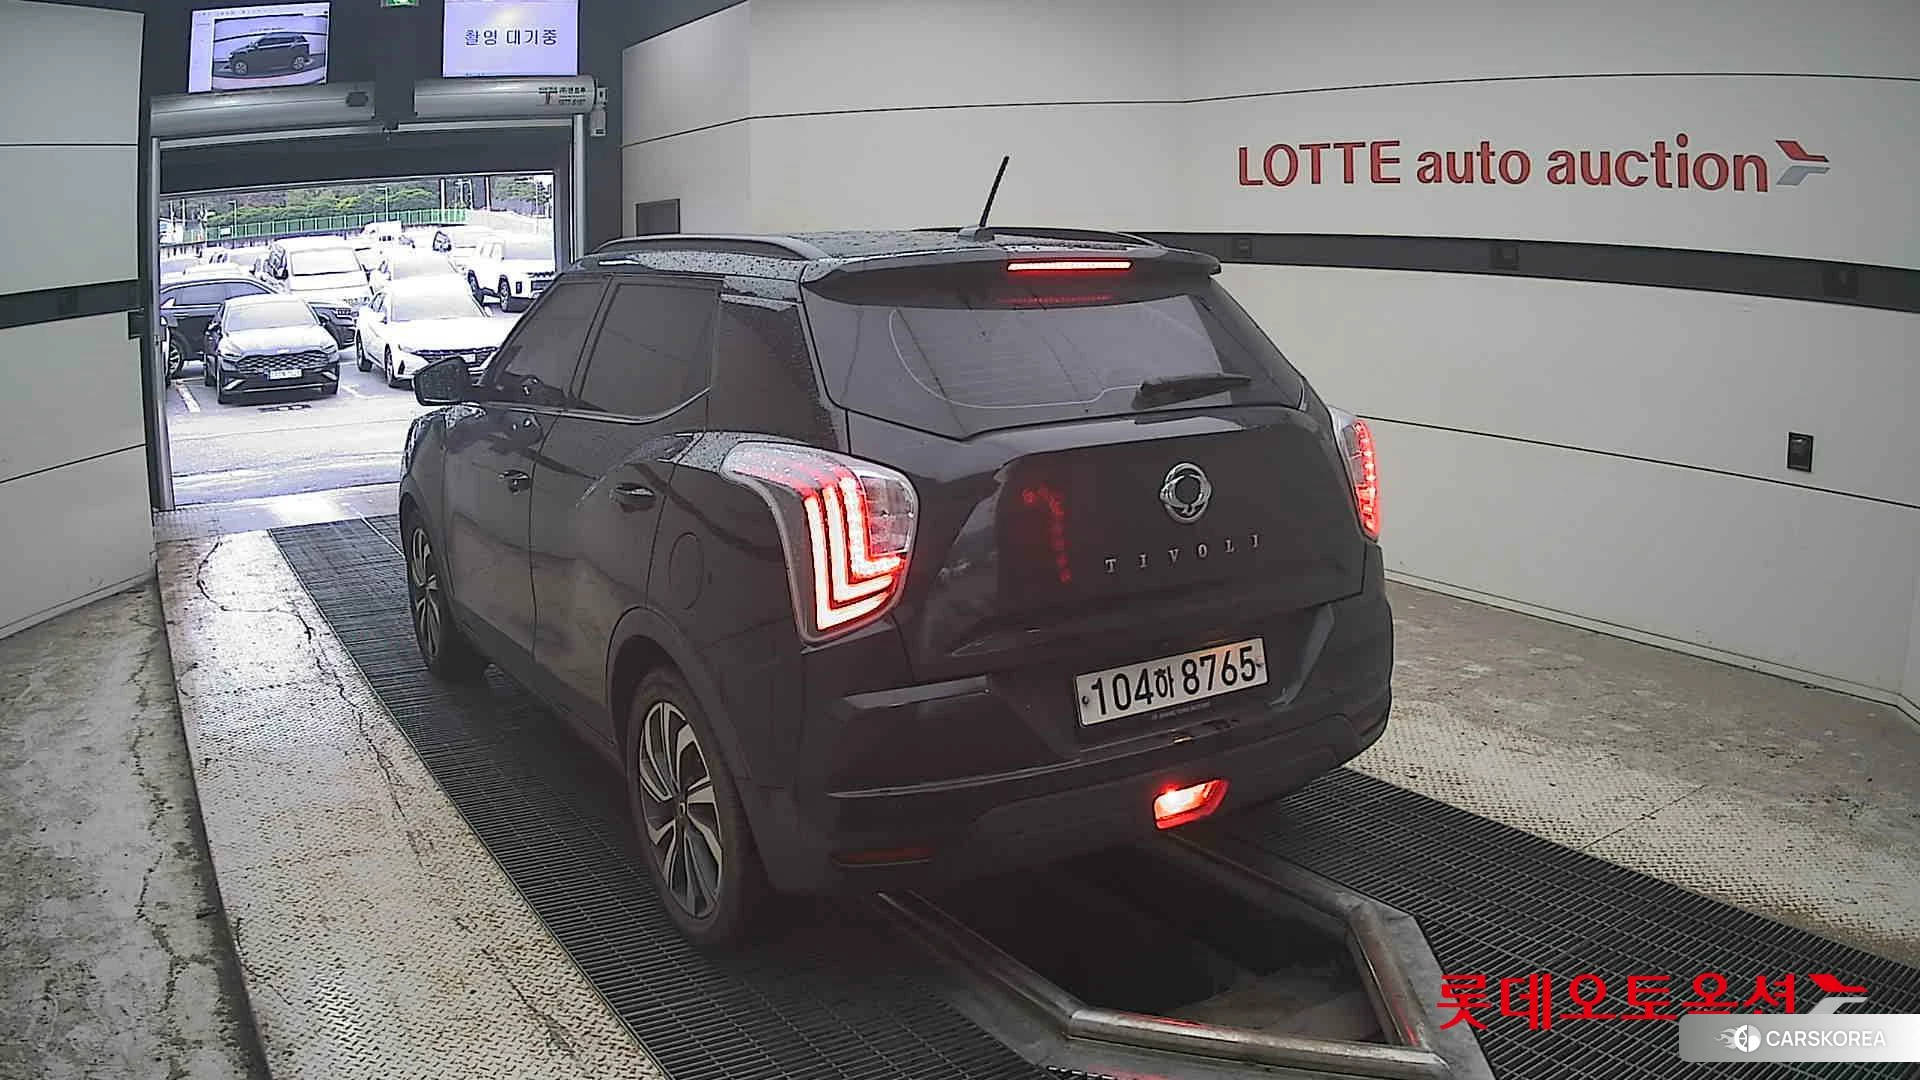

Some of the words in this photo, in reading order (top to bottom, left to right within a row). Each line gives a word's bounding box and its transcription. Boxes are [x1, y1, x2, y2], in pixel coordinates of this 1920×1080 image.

[464, 28, 497, 46] 촬영
[506, 28, 558, 46] 대기중
[1238, 140, 1401, 187] LOTTE
[1416, 140, 1531, 186] auto
[1547, 133, 1768, 193] auction
[1105, 533, 1260, 574] TIVOLI
[1091, 664, 1174, 716] 104하
[1181, 645, 1257, 696] 8765
